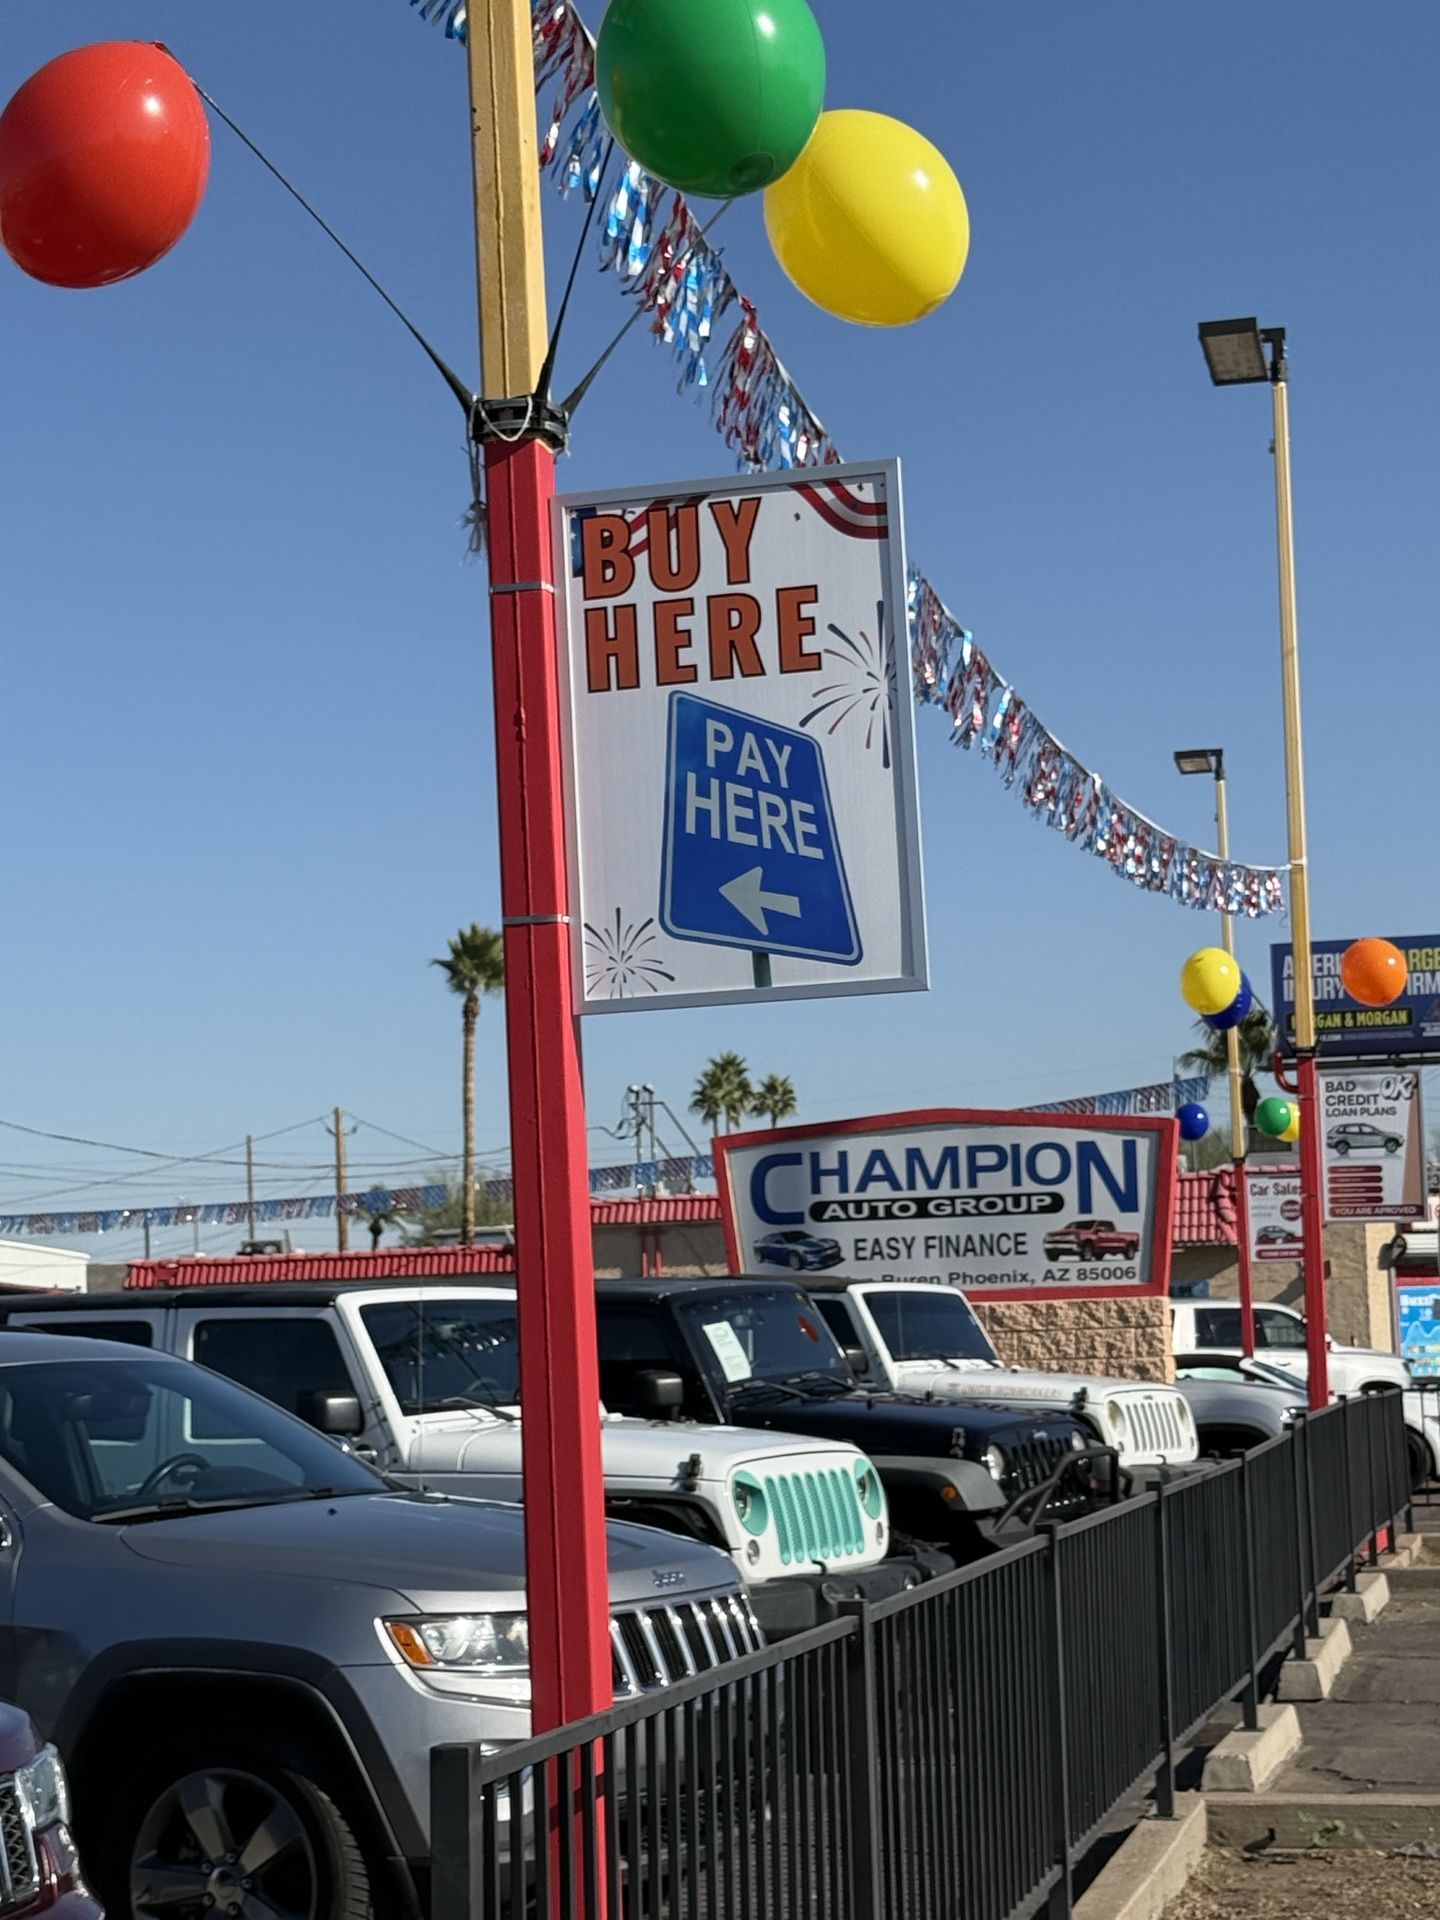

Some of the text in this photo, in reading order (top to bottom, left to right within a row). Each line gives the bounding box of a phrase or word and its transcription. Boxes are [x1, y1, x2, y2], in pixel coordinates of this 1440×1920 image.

[581, 498, 762, 599] BUY
[584, 585, 822, 693] HERE
[705, 718, 792, 788] PAY
[684, 771, 825, 861] HERE
[1283, 976, 1344, 1002] IURY
[1344, 1012, 1354, 1028] &
[1355, 1009, 1408, 1026] MORGAN
[1325, 1074, 1414, 1101] BAD OK
[1325, 1094, 1379, 1107] CREDIT
[1325, 1107, 1397, 1118] LOAN PLANS
[750, 1139, 1139, 1225] CHAMPION
[1249, 1184, 1269, 1197] Car
[821, 1193, 1053, 1221] AUTO GROUP
[853, 1232, 1028, 1261] EASY FINANCE
[948, 1270, 1036, 1286] Phoenix,
[1042, 1268, 1070, 1282] AZ
[1076, 1266, 1136, 1281] 85006
